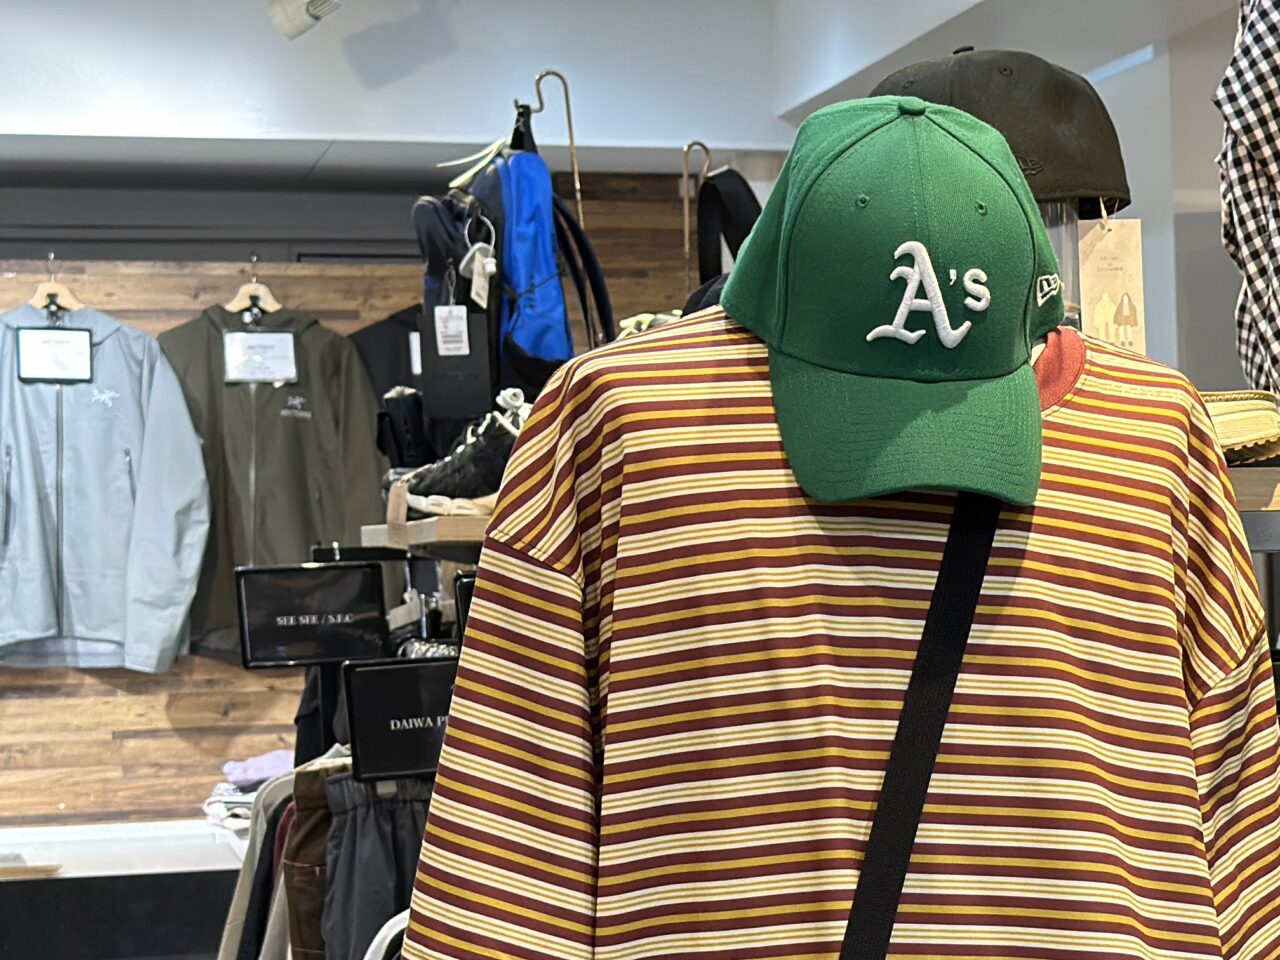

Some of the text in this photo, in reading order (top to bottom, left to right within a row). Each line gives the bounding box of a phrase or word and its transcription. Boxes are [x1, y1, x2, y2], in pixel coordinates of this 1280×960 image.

[866, 241, 991, 349] A's
[275, 615, 297, 626] SEE
[299, 614, 319, 626] SEE
[390, 716, 433, 731] DAIWA
